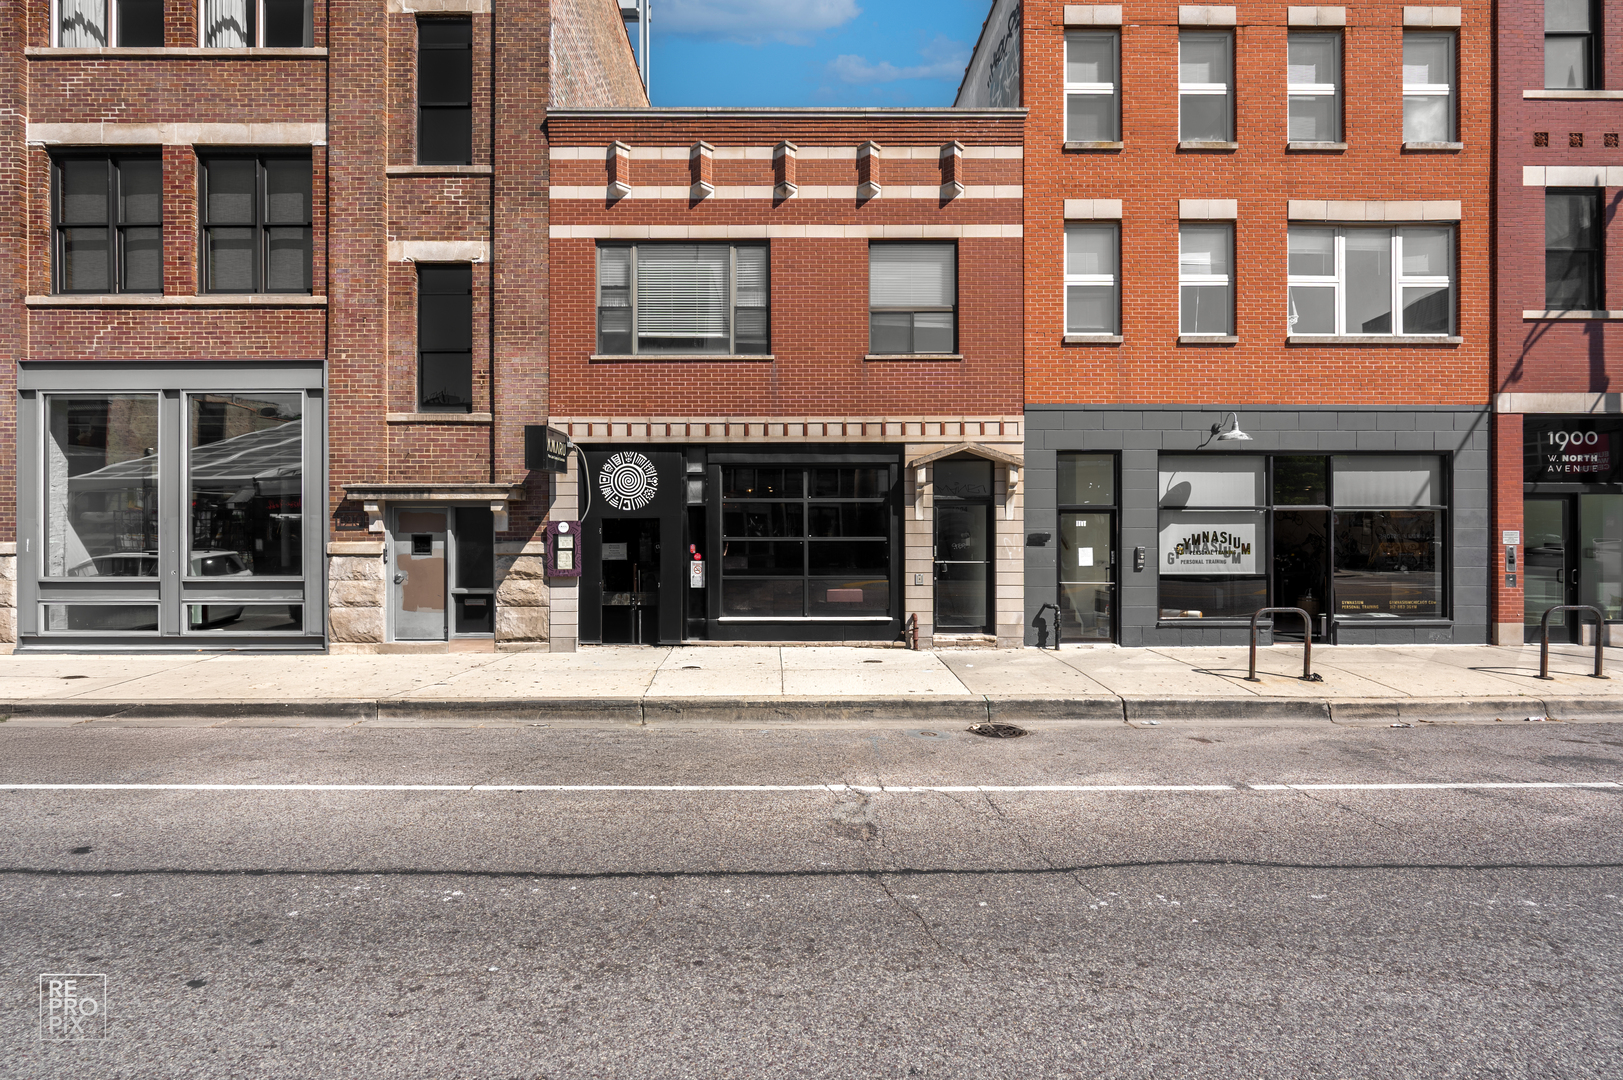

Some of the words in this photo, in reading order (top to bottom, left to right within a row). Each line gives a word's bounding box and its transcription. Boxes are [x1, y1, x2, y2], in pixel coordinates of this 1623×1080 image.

[1547, 431, 1598, 451] 1900
[1547, 454, 1559, 462] W.
[1562, 454, 1598, 462] NORTH
[1176, 531, 1251, 555] GYMNASIUM
